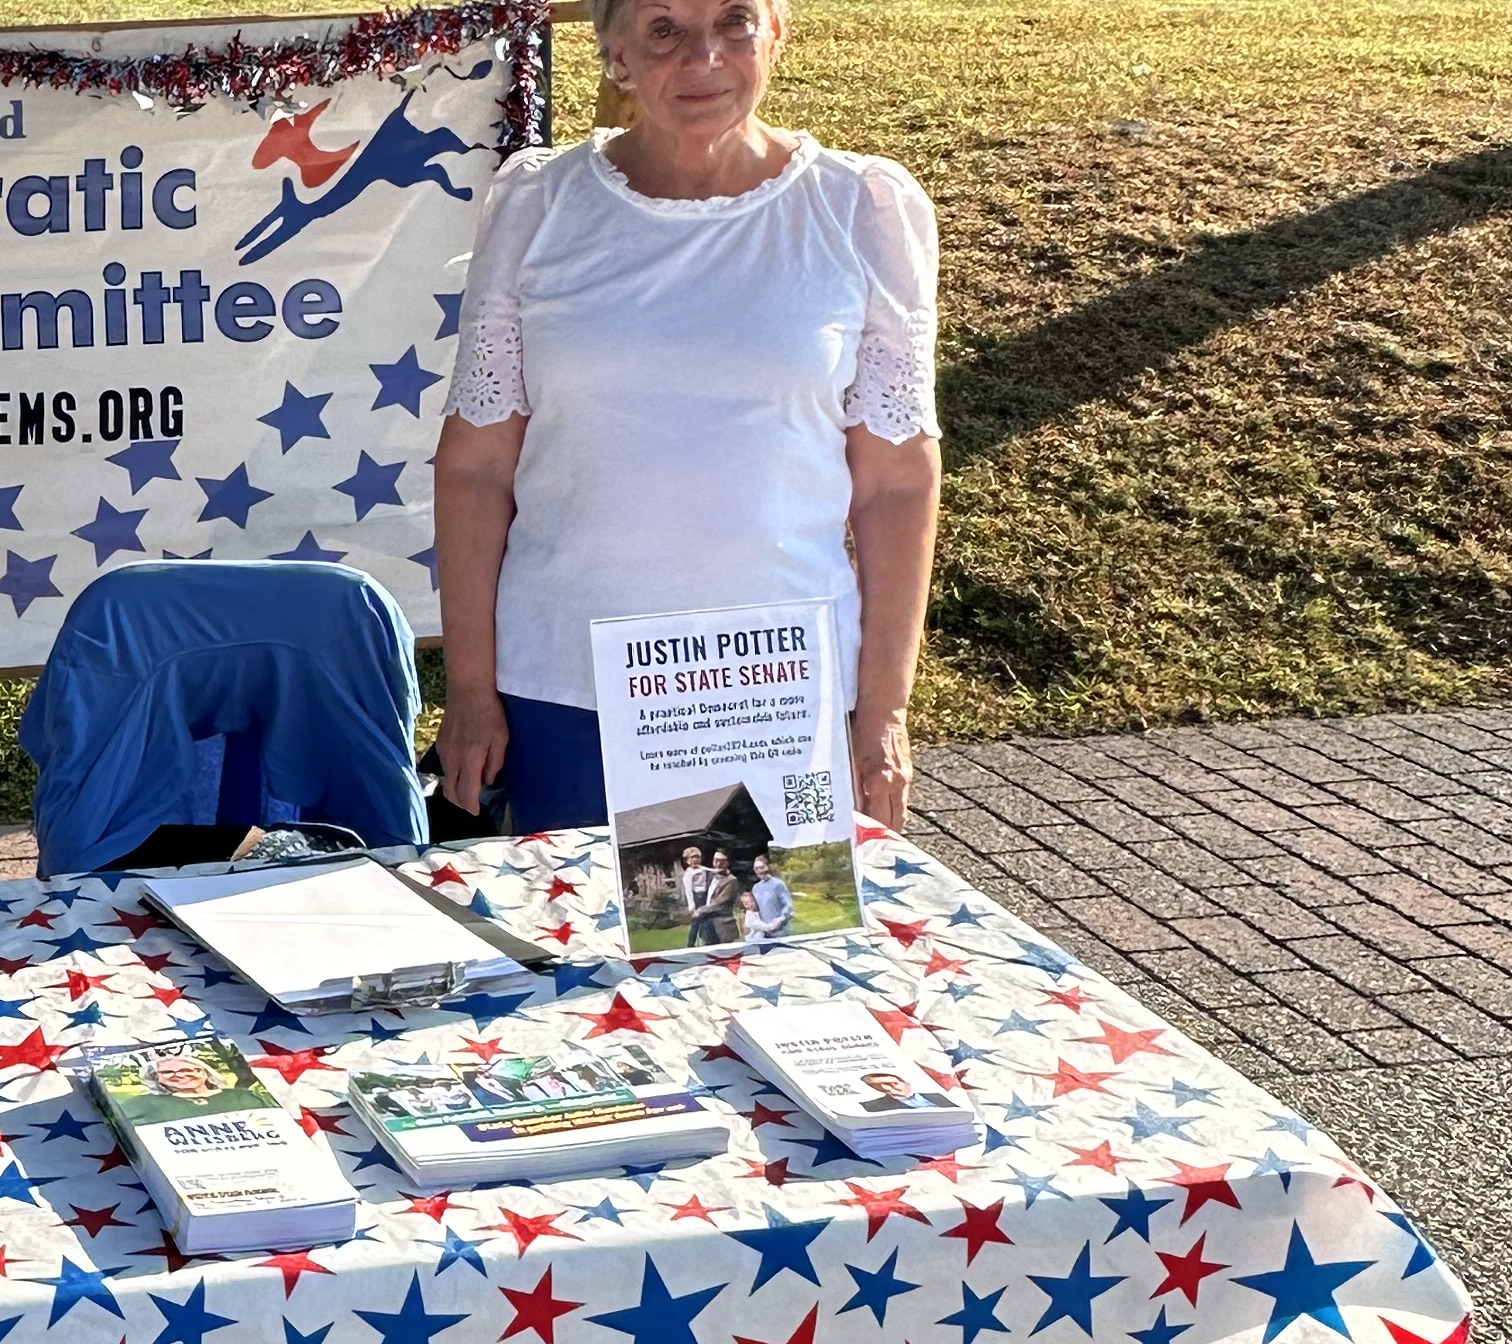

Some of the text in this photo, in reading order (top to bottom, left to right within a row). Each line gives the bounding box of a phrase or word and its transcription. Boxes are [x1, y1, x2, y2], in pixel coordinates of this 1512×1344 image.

[625, 626, 806, 669] JUSTIN POTTER
[628, 659, 810, 697] FOR STATE SENATE
